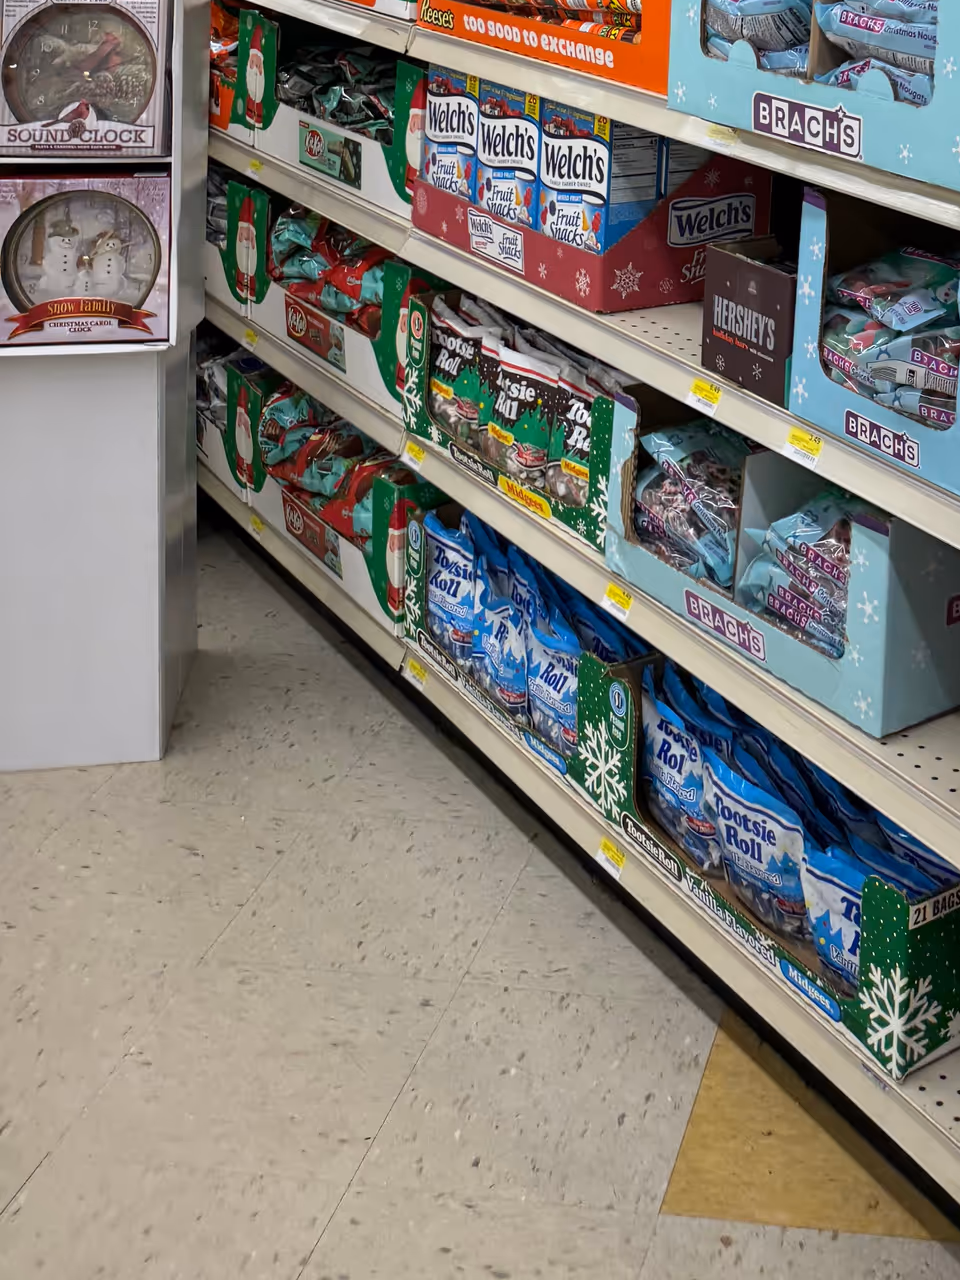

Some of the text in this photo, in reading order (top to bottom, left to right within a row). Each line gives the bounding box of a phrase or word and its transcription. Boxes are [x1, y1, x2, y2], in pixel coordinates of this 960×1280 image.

[528, 93, 538, 104] 26
[428, 99, 476, 137] Welch's
[7, 129, 146, 143] SOUND CLOCK
[481, 121, 536, 162] Welch's
[437, 159, 456, 177] Fruit
[544, 141, 606, 185] Welch's
[432, 173, 459, 194] Snacks
[491, 184, 515, 203] Fruit
[487, 197, 518, 221] Snacks
[556, 207, 582, 228] Fruit
[677, 202, 753, 239] Welch's
[470, 217, 493, 235] Welch's
[550, 221, 585, 248] Snacks
[498, 241, 522, 260] Snacks
[501, 232, 519, 249] Fruit
[713, 293, 776, 352] HERSHEY'S
[435, 351, 462, 377] Roll
[505, 482, 546, 513] Midgees
[429, 572, 462, 600] Roll
[539, 662, 570, 695] Roll
[713, 791, 778, 848] Tootsie
[725, 822, 764, 864] Roll
[913, 907, 930, 927] 21
[685, 868, 835, 1015] Vanilla Flavored Midgees
